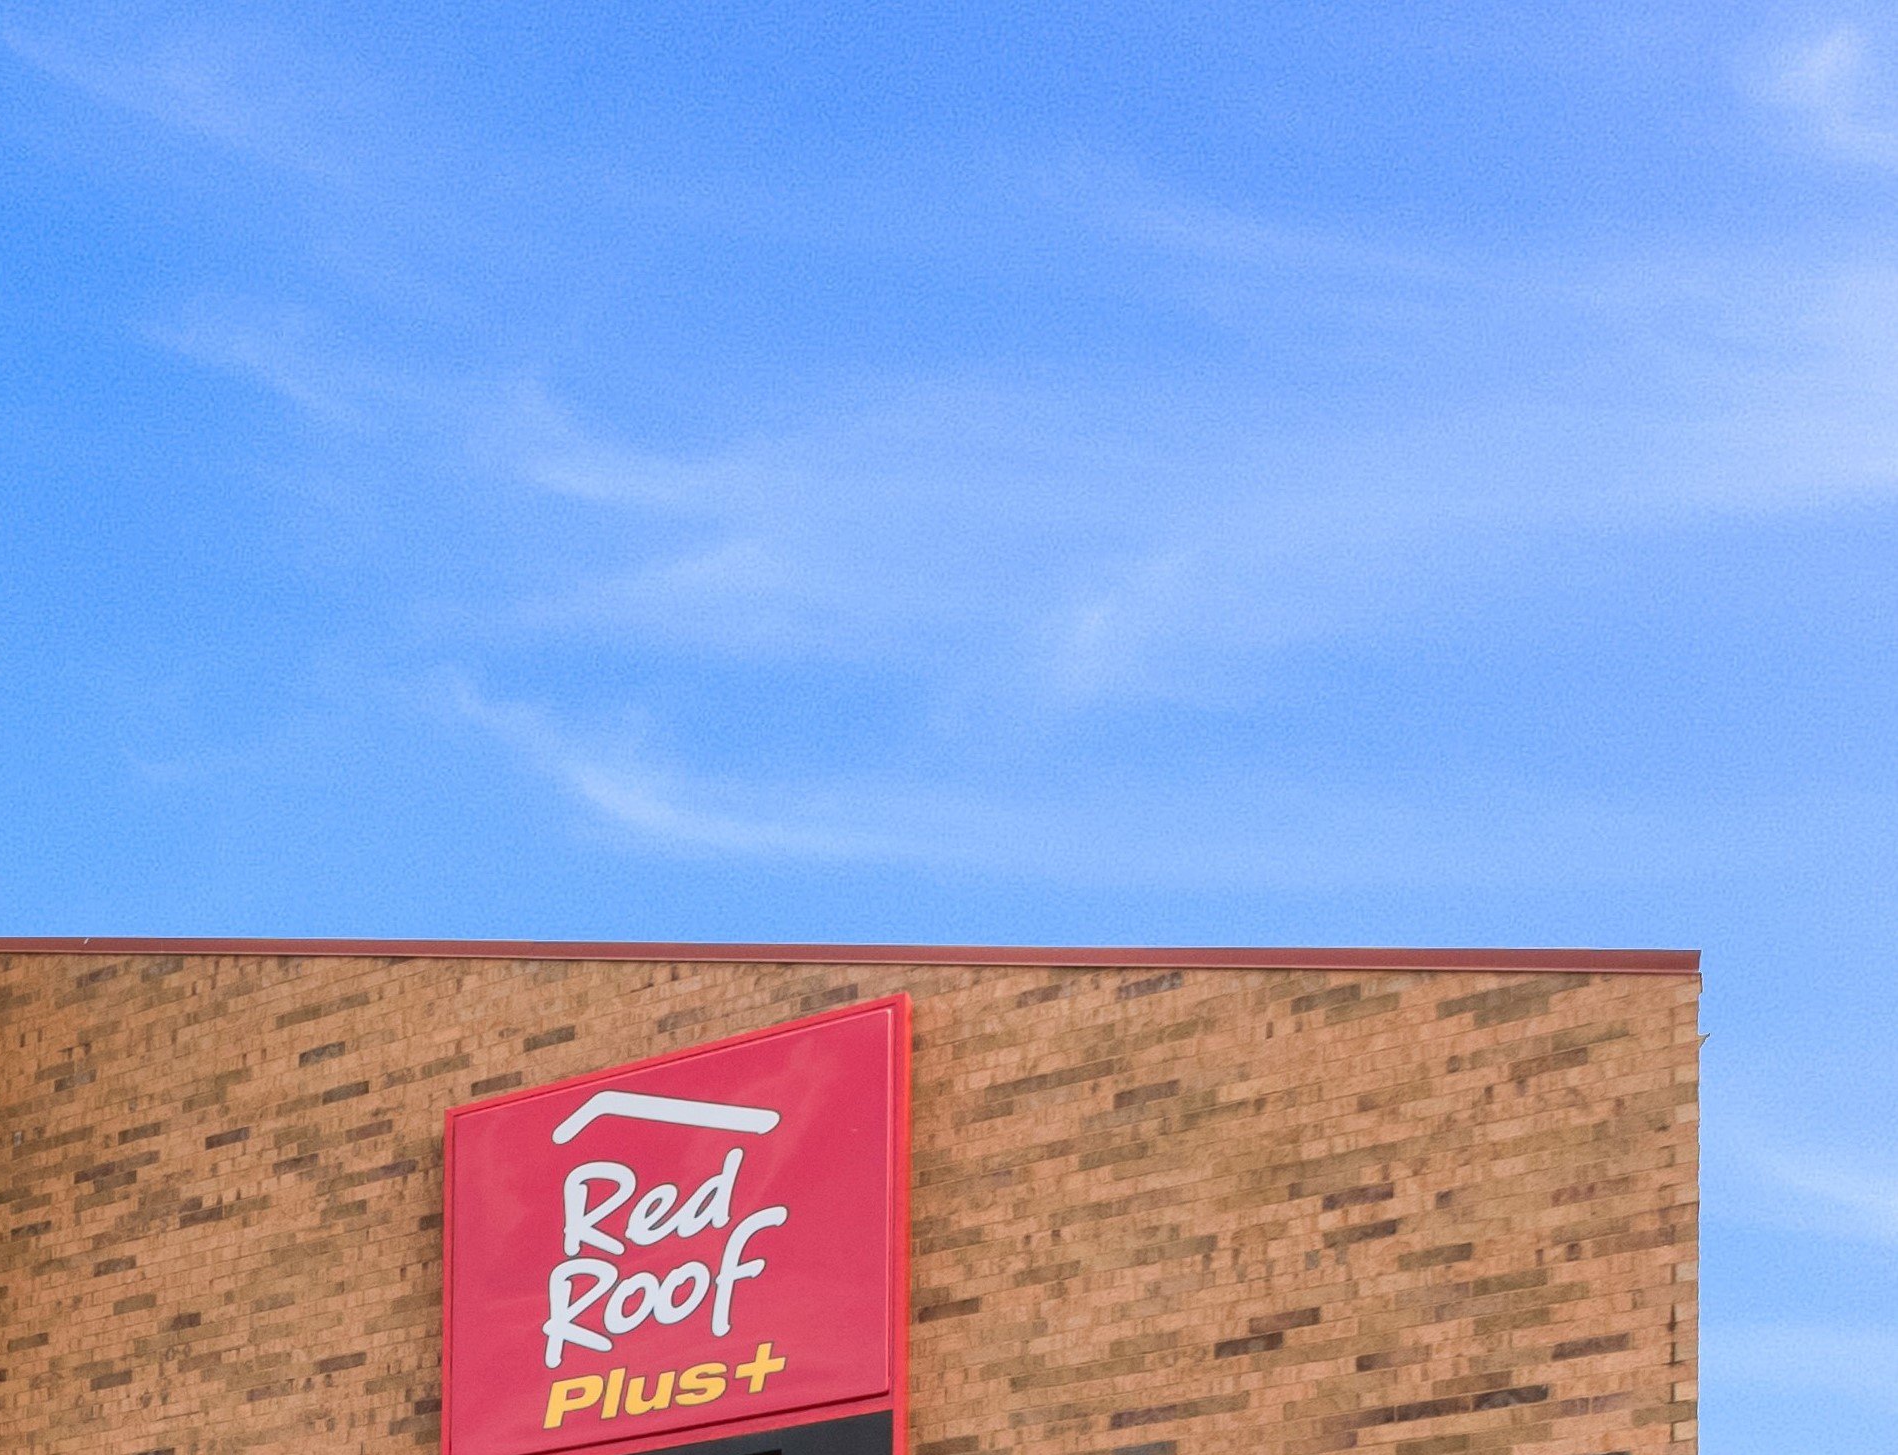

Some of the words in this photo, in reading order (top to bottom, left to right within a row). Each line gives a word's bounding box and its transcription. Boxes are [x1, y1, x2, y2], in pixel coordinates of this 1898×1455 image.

[564, 1148, 743, 1256] Red
[542, 1206, 788, 1368] Roof
[543, 1343, 786, 1429] Plus+
